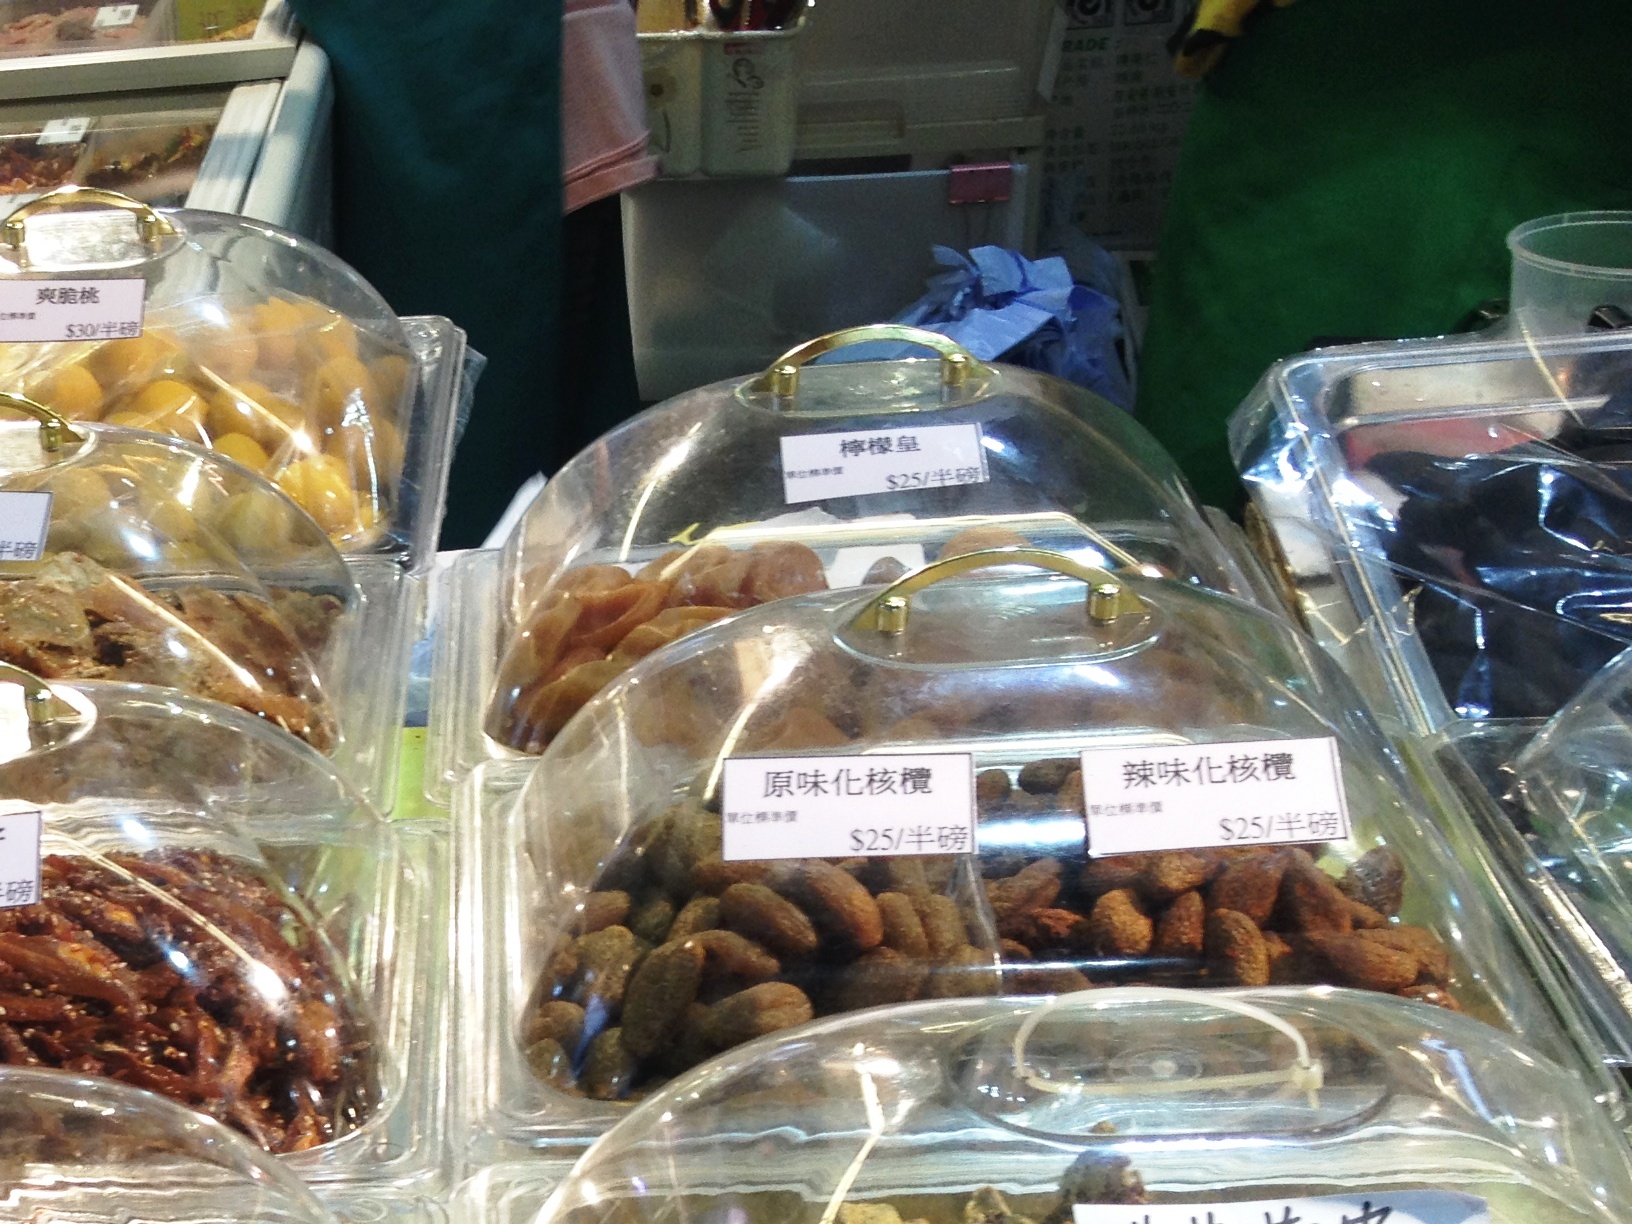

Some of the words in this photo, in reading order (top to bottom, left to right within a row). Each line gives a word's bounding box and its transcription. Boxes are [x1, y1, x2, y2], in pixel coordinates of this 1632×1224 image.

[35, 286, 100, 305] 爽脆桃
[65, 321, 139, 338] $30/半磅
[839, 435, 921, 458] 檸檬皇
[886, 466, 981, 490] $25/半磅
[763, 766, 933, 798] 原味化核欖
[1123, 752, 1296, 789] 辣味化核欖
[850, 824, 969, 852] $25/半磅
[1219, 810, 1338, 841] $25/半磅
